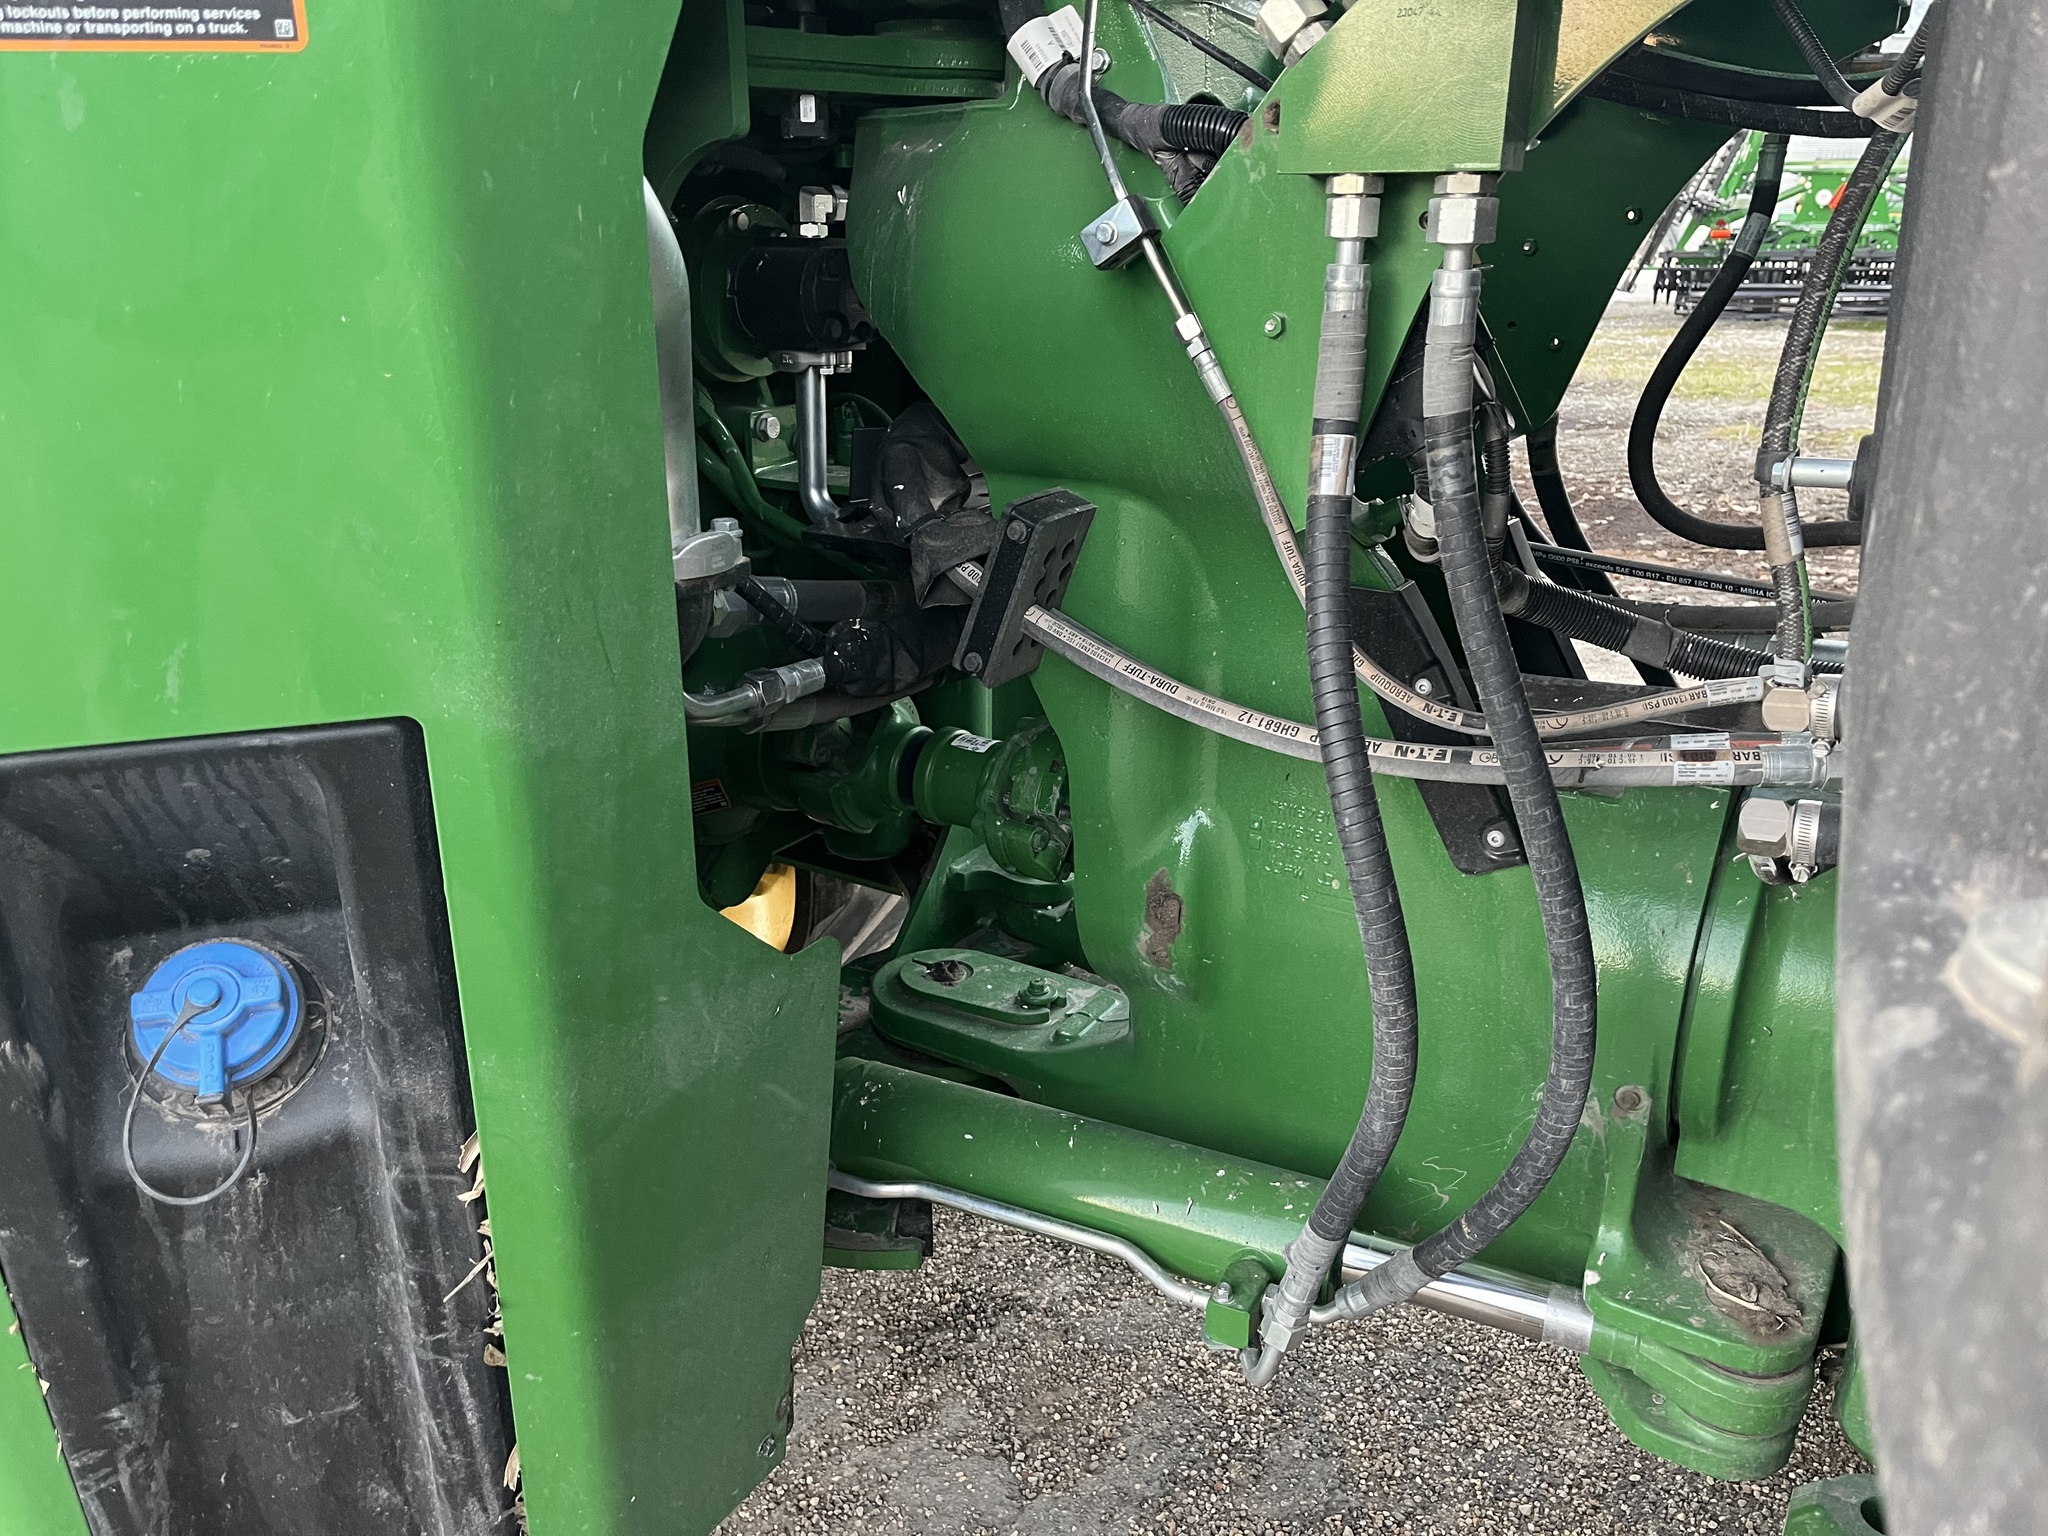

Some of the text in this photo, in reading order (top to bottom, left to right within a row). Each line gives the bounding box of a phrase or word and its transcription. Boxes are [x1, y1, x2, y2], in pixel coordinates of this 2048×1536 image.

[5, 6, 261, 22] lockouts before performing services
[1, 21, 249, 36] machine or transporting on a truck.
[1614, 566, 1630, 574] SAE
[1631, 569, 1645, 577] 100
[1678, 577, 1691, 585] 857
[1709, 582, 1722, 590] DN
[1724, 584, 1733, 592] 10
[1739, 586, 1764, 596] MSHA
[1122, 664, 1179, 694] DURA-TUFF
[1368, 672, 1413, 704] AEROQUIP
[1688, 689, 1707, 700] BAR
[1236, 709, 1300, 737] GH681-12
[1732, 751, 1760, 760] BAR
